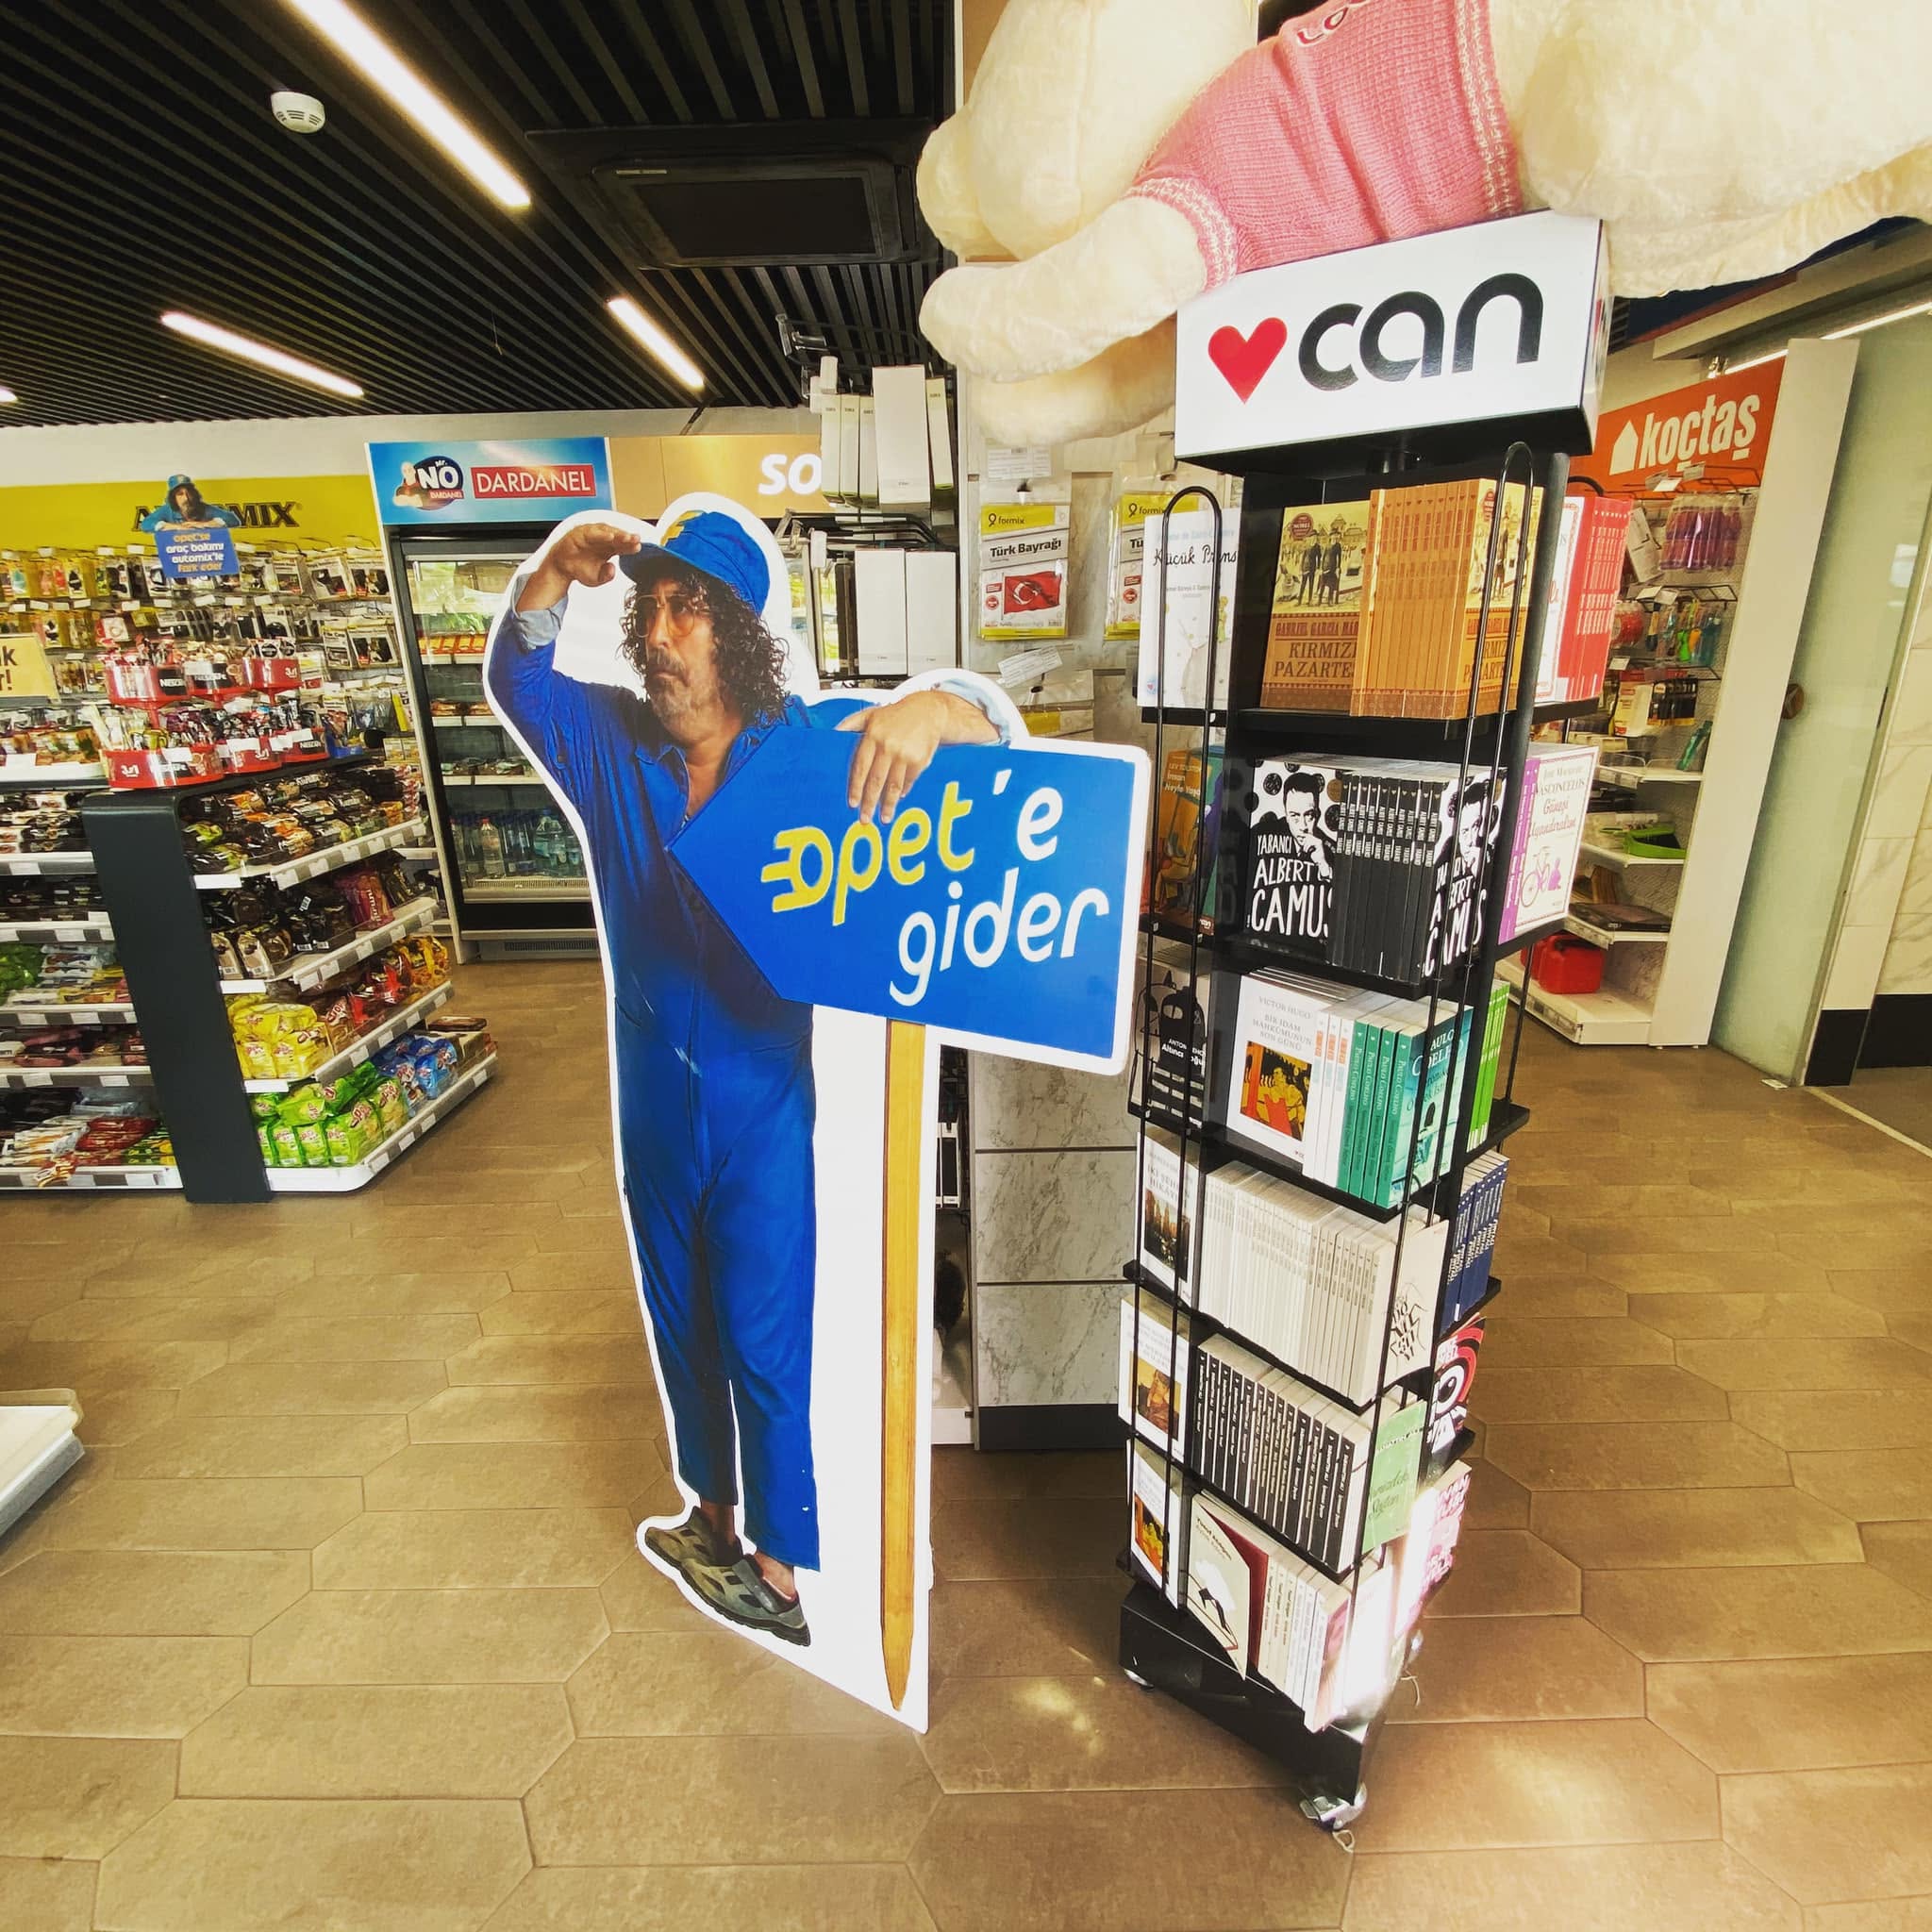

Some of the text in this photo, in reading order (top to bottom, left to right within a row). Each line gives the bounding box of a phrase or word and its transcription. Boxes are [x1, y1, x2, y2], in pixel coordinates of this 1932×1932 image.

[1298, 273, 1543, 391] can
[1639, 392, 1760, 470] koçtaş
[417, 466, 459, 490] NO
[476, 471, 591, 493] DARDANEL
[998, 516, 1025, 525] formix
[991, 538, 1061, 558] Türk Bayrağı
[1129, 537, 1143, 549] Tü
[1202, 544, 1237, 563] Prns
[1274, 661, 1356, 677] PAZARTE
[1257, 834, 1292, 856] YABANCI
[1253, 858, 1315, 889] ALBERT
[889, 867, 1109, 1007] gider
[1169, 1039, 1187, 1050] ANTON
[1430, 1028, 1455, 1051] AULO
